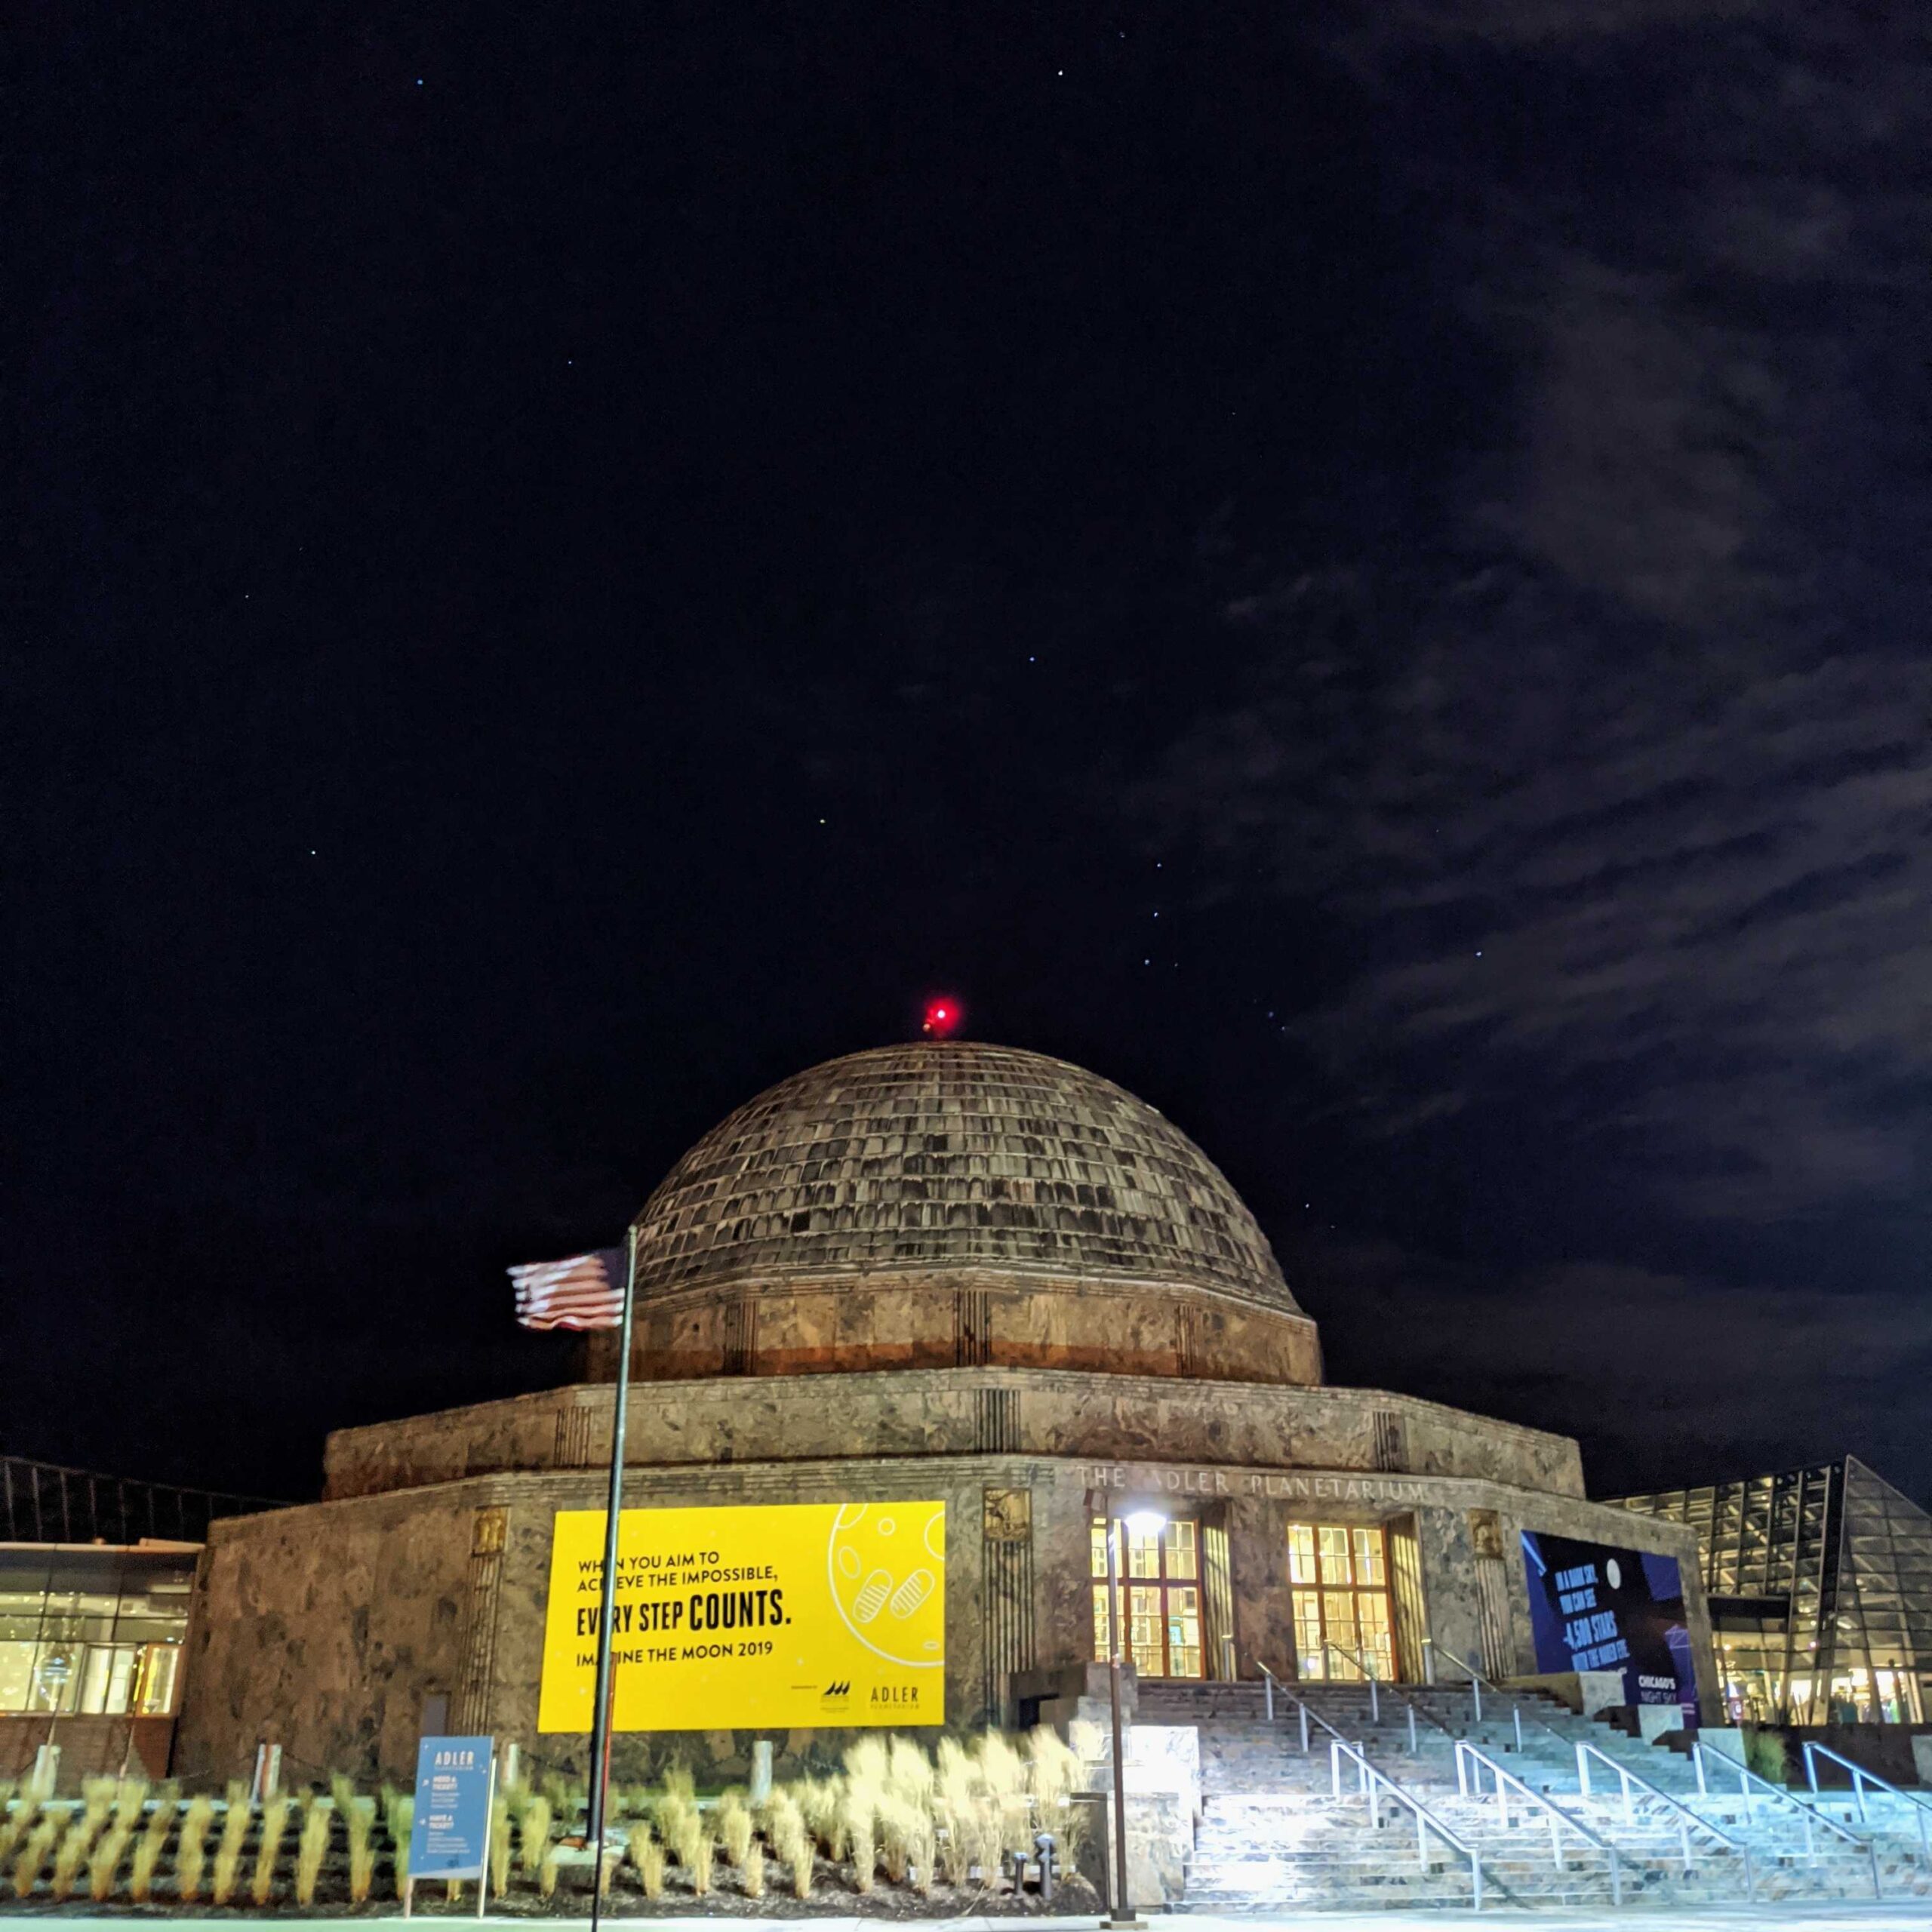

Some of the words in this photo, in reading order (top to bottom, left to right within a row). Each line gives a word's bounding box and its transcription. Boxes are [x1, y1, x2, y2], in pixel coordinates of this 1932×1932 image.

[1075, 1466, 1125, 1487] THE
[1251, 1475, 1425, 1503] PLANETARIUM
[578, 1558, 624, 1573] WHN
[629, 1555, 661, 1570] YOU
[666, 1553, 695, 1567] AIM
[699, 1551, 719, 1565] TO
[577, 1574, 644, 1592] ACEVE
[648, 1573, 677, 1587] THE
[682, 1565, 778, 1585] IMPOSSIBLE,
[577, 1604, 633, 1636] EVRY
[638, 1601, 683, 1632] STEP
[690, 1589, 792, 1631] COUNTS.
[577, 1650, 643, 1667] IMINE
[648, 1647, 677, 1662] THE
[681, 1643, 733, 1660] MOON
[738, 1641, 773, 1657] 2019
[870, 1686, 918, 1703] ADLER
[434, 1751, 475, 1766] ADLER
